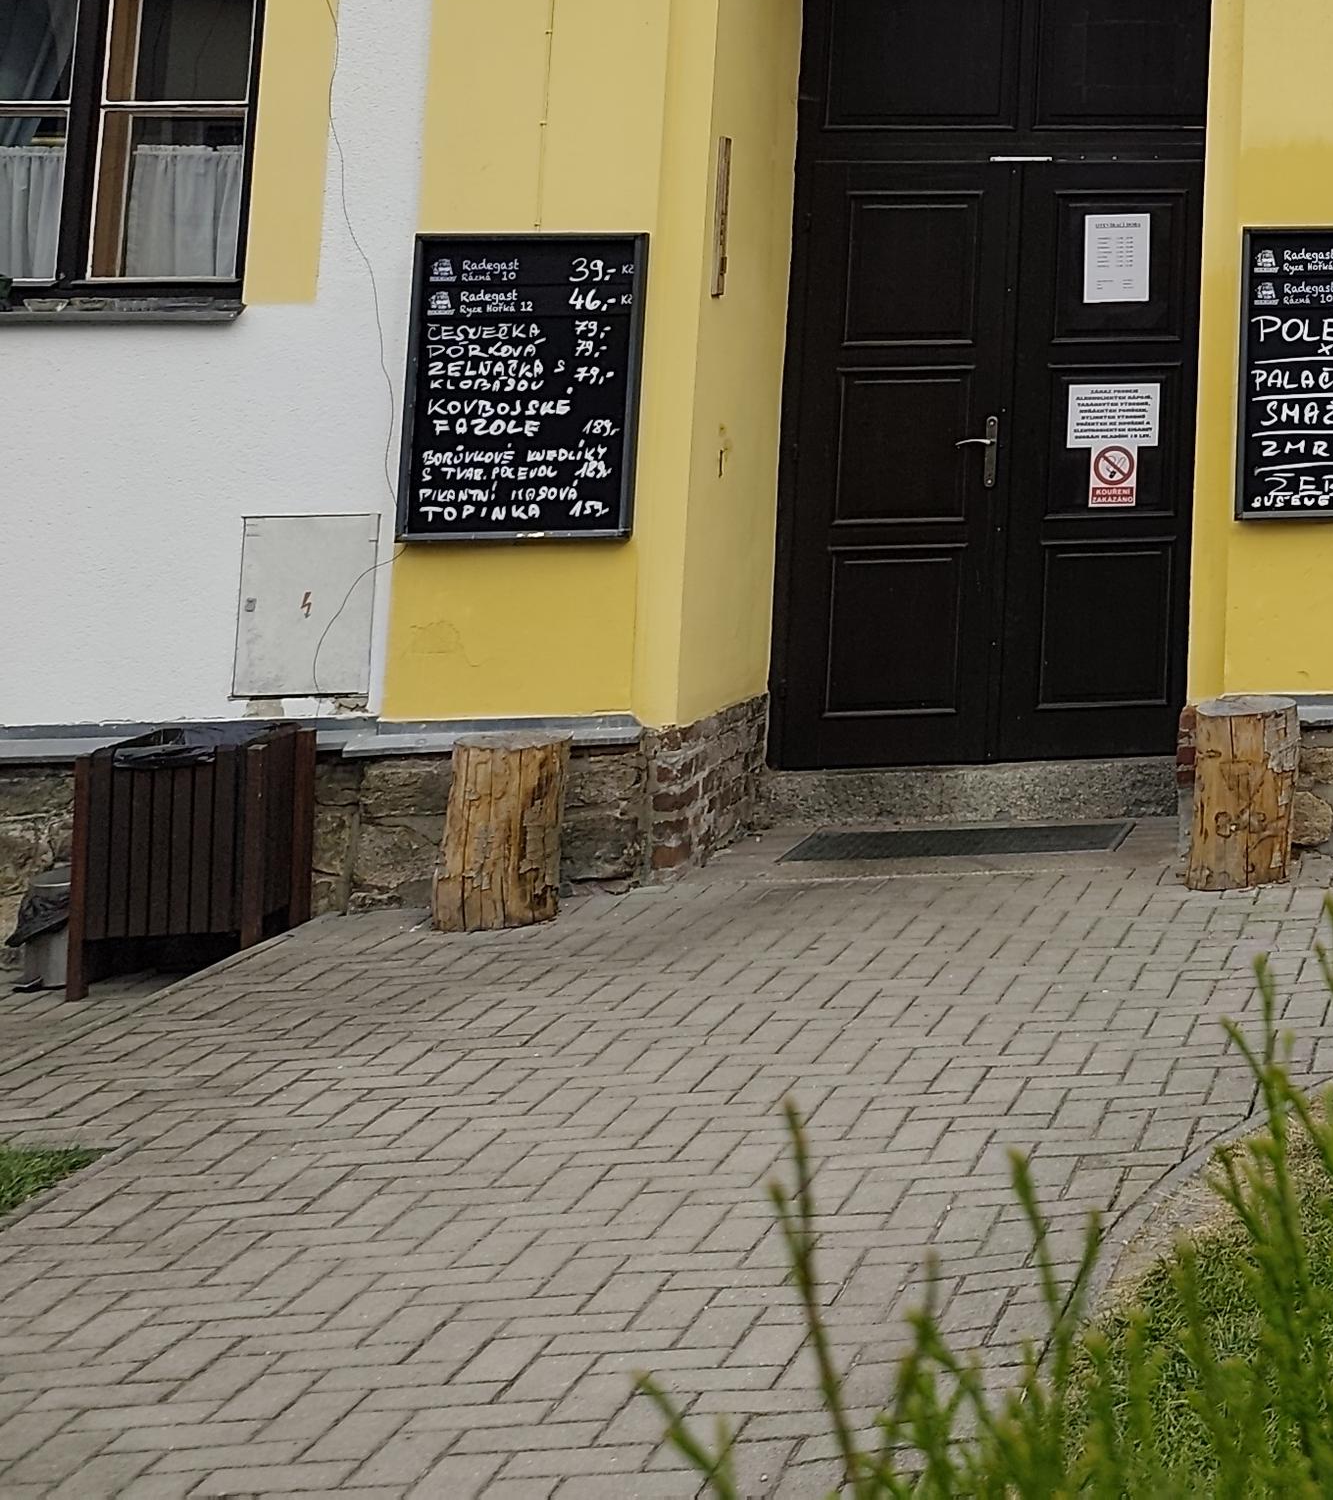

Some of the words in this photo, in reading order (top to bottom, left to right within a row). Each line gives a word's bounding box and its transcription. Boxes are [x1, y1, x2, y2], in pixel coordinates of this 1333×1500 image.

[462, 258, 520, 275] Radegast
[569, 257, 616, 282] 39,-
[1282, 262, 1305, 275] Ryze
[1307, 260, 1333, 271] Hořká
[461, 271, 491, 281] Rázná
[502, 271, 516, 281] 10
[460, 289, 518, 305] Radegast
[568, 287, 616, 312] 46,-
[1282, 294, 1311, 305] Rázná
[1320, 293, 1333, 304] 10
[459, 304, 483, 318] Ryze
[486, 302, 516, 313] Hořká
[520, 301, 533, 312] 12
[426, 323, 541, 341] ČESNEČKA
[574, 320, 611, 339] 79,-
[574, 339, 608, 358] 79,-
[429, 376, 545, 392] KLOBÁSOU
[573, 366, 614, 385] 79,-
[427, 387, 574, 417] KOVBOJSKÉ
[432, 418, 541, 437] FAZOLE
[418, 504, 541, 522] TOPINKA
